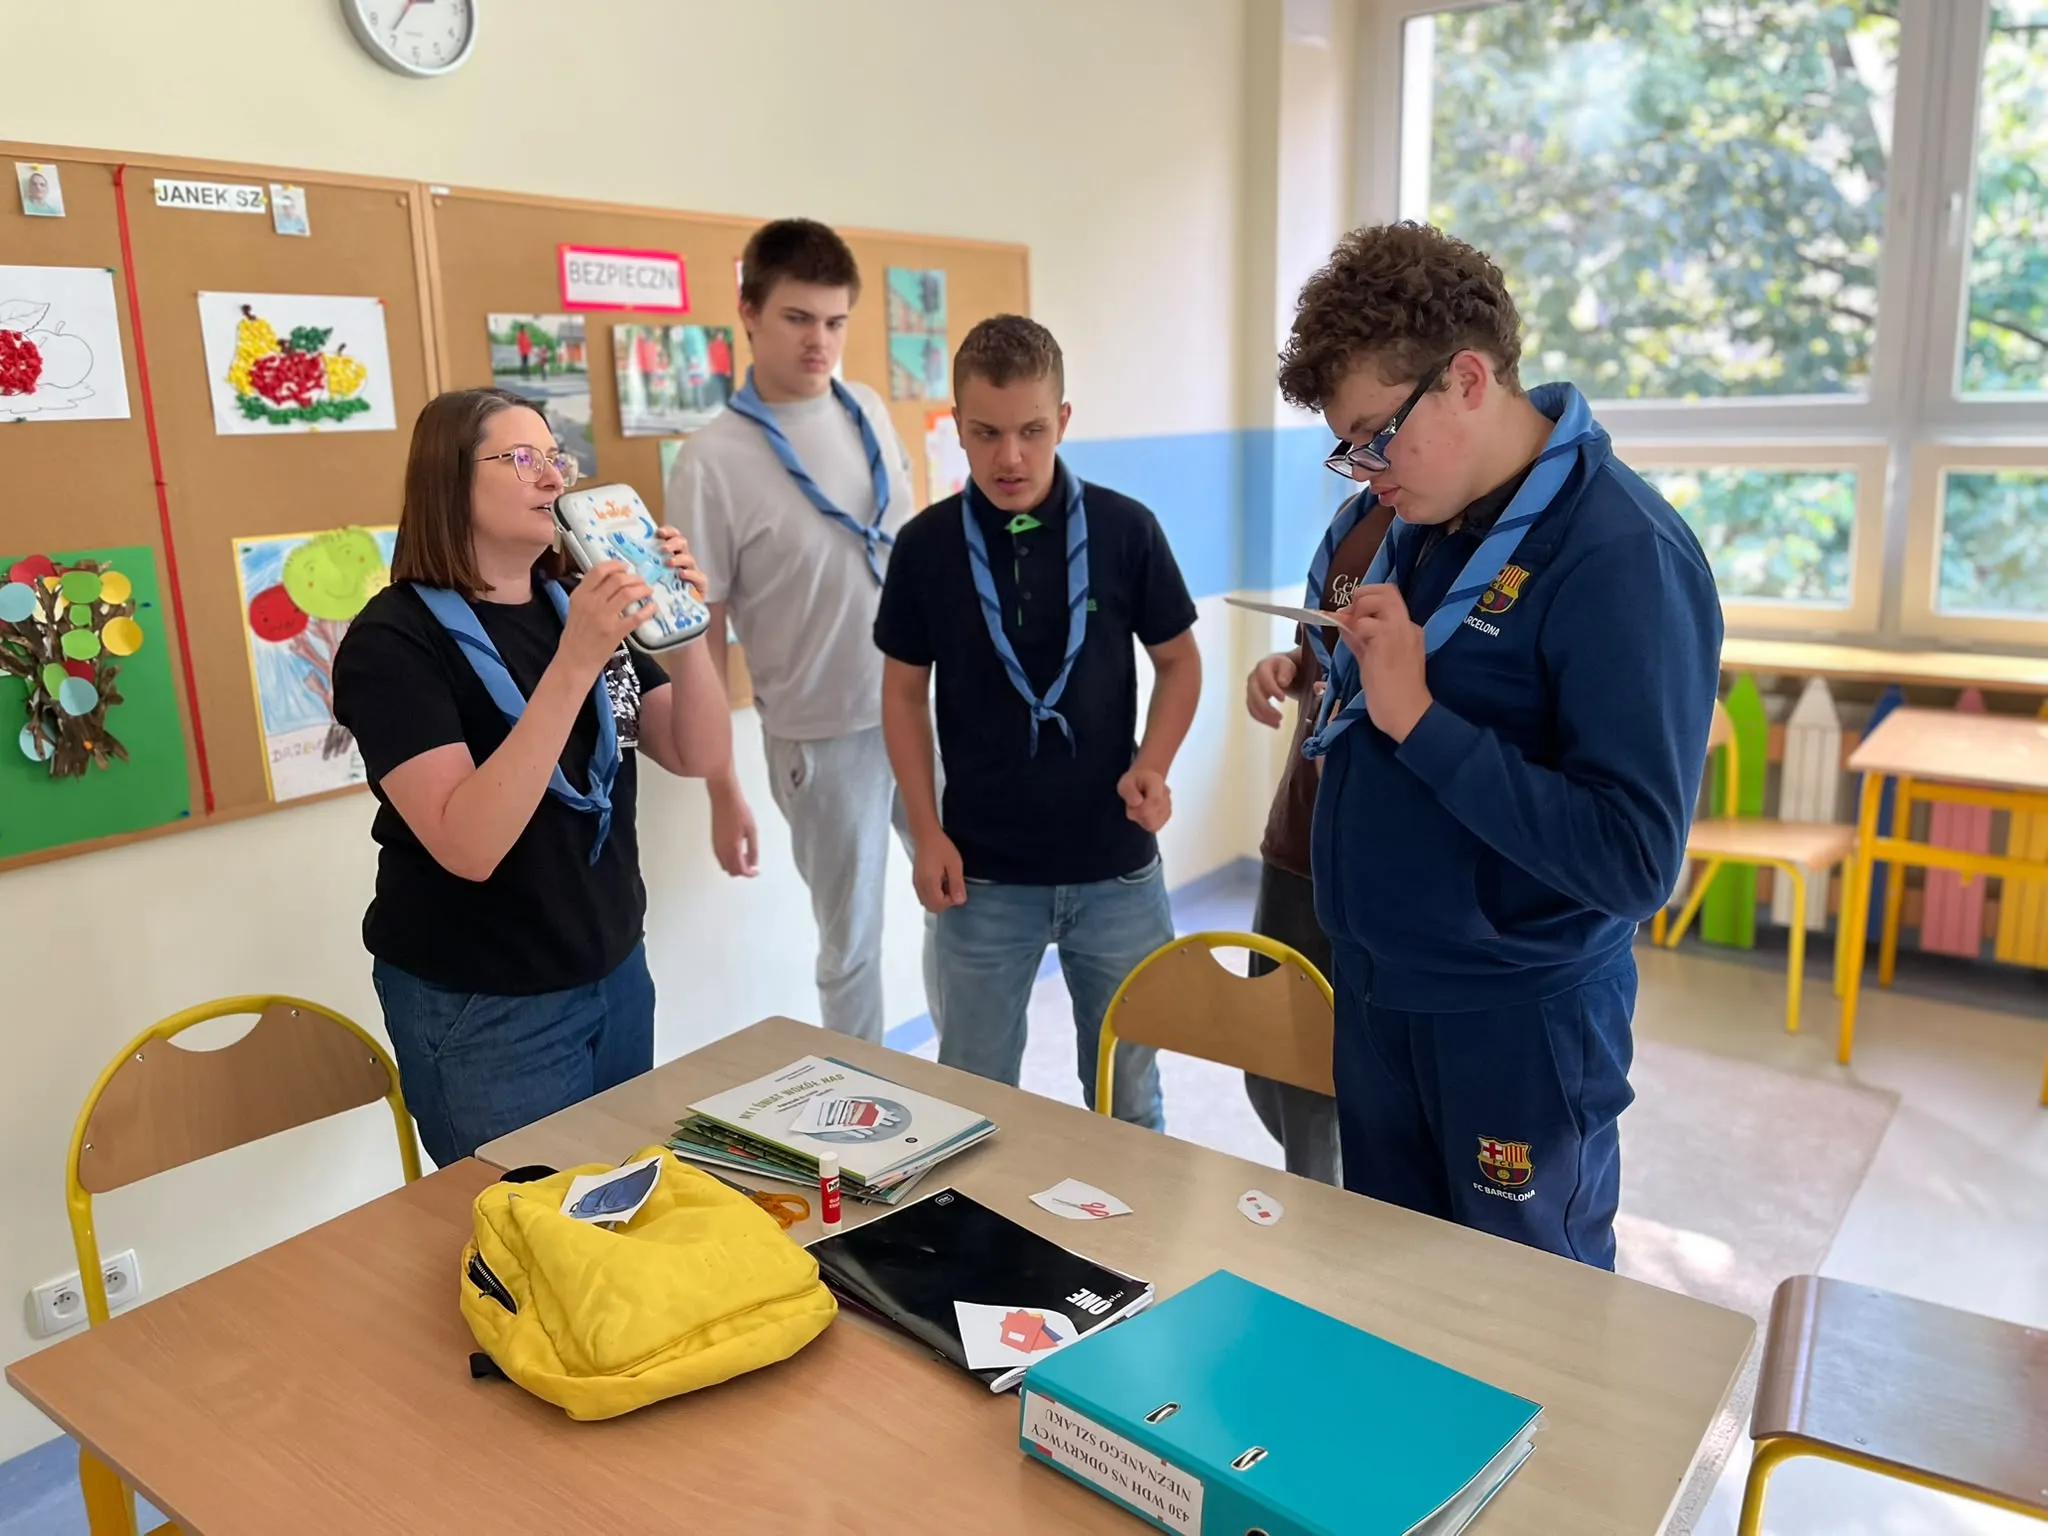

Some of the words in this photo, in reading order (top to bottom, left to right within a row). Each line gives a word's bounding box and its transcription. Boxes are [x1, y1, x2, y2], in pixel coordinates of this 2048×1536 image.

[158, 184, 228, 206] JANEK
[236, 190, 262, 208] SZ
[820, 1073, 845, 1085] NAS
[1472, 1182, 1484, 1192] FC
[1484, 1185, 1536, 1202] BARCELONA
[1065, 1287, 1113, 1316] ONE
[1045, 1408, 1097, 1445] SZLAKU
[1031, 1423, 1109, 1475] ODKRYWCY
[1099, 1439, 1192, 1503] NIEZNANEGO
[1111, 1468, 1129, 1489] NS
[1131, 1482, 1166, 1510] WDH
[1168, 1503, 1190, 1523] 430
